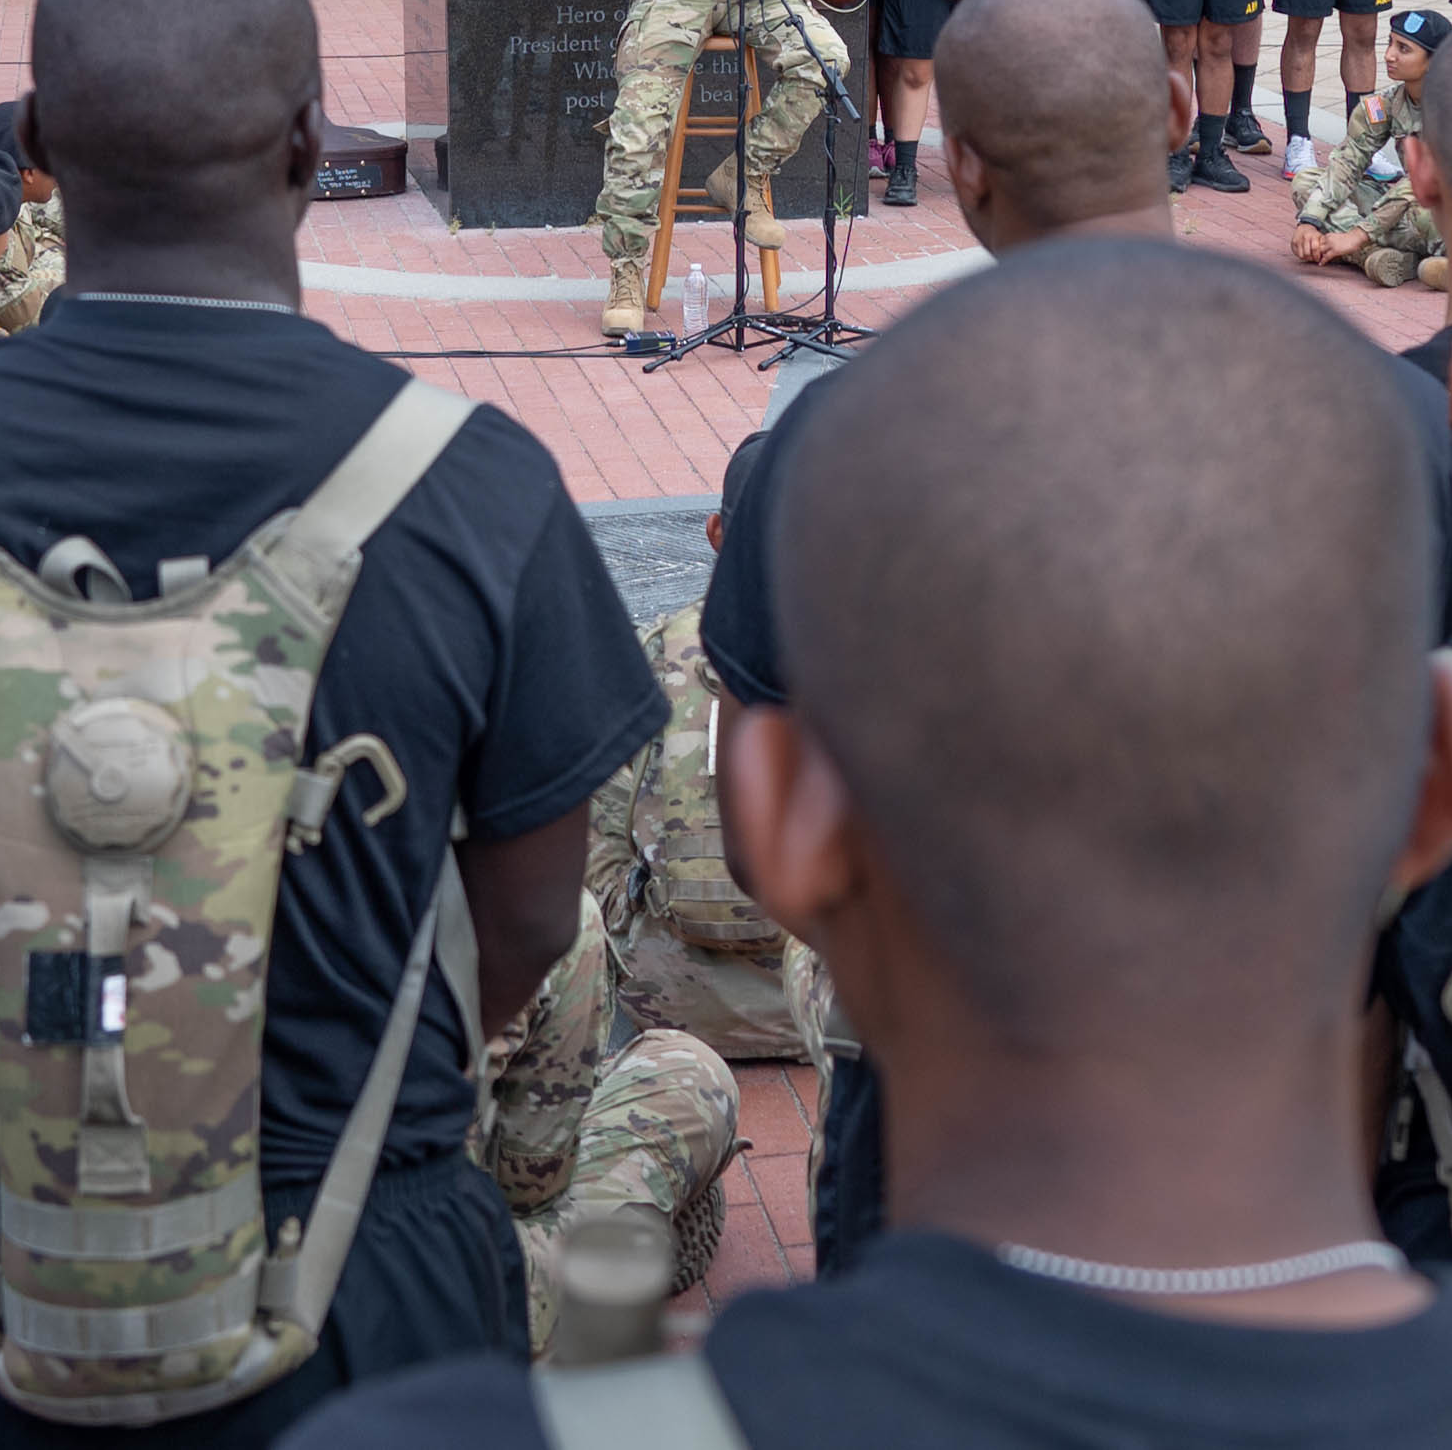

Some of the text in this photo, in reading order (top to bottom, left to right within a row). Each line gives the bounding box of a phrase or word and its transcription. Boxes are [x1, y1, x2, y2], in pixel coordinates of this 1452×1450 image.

[556, 5, 606, 25] Hero
[509, 33, 600, 55] President
[565, 90, 606, 113] post
